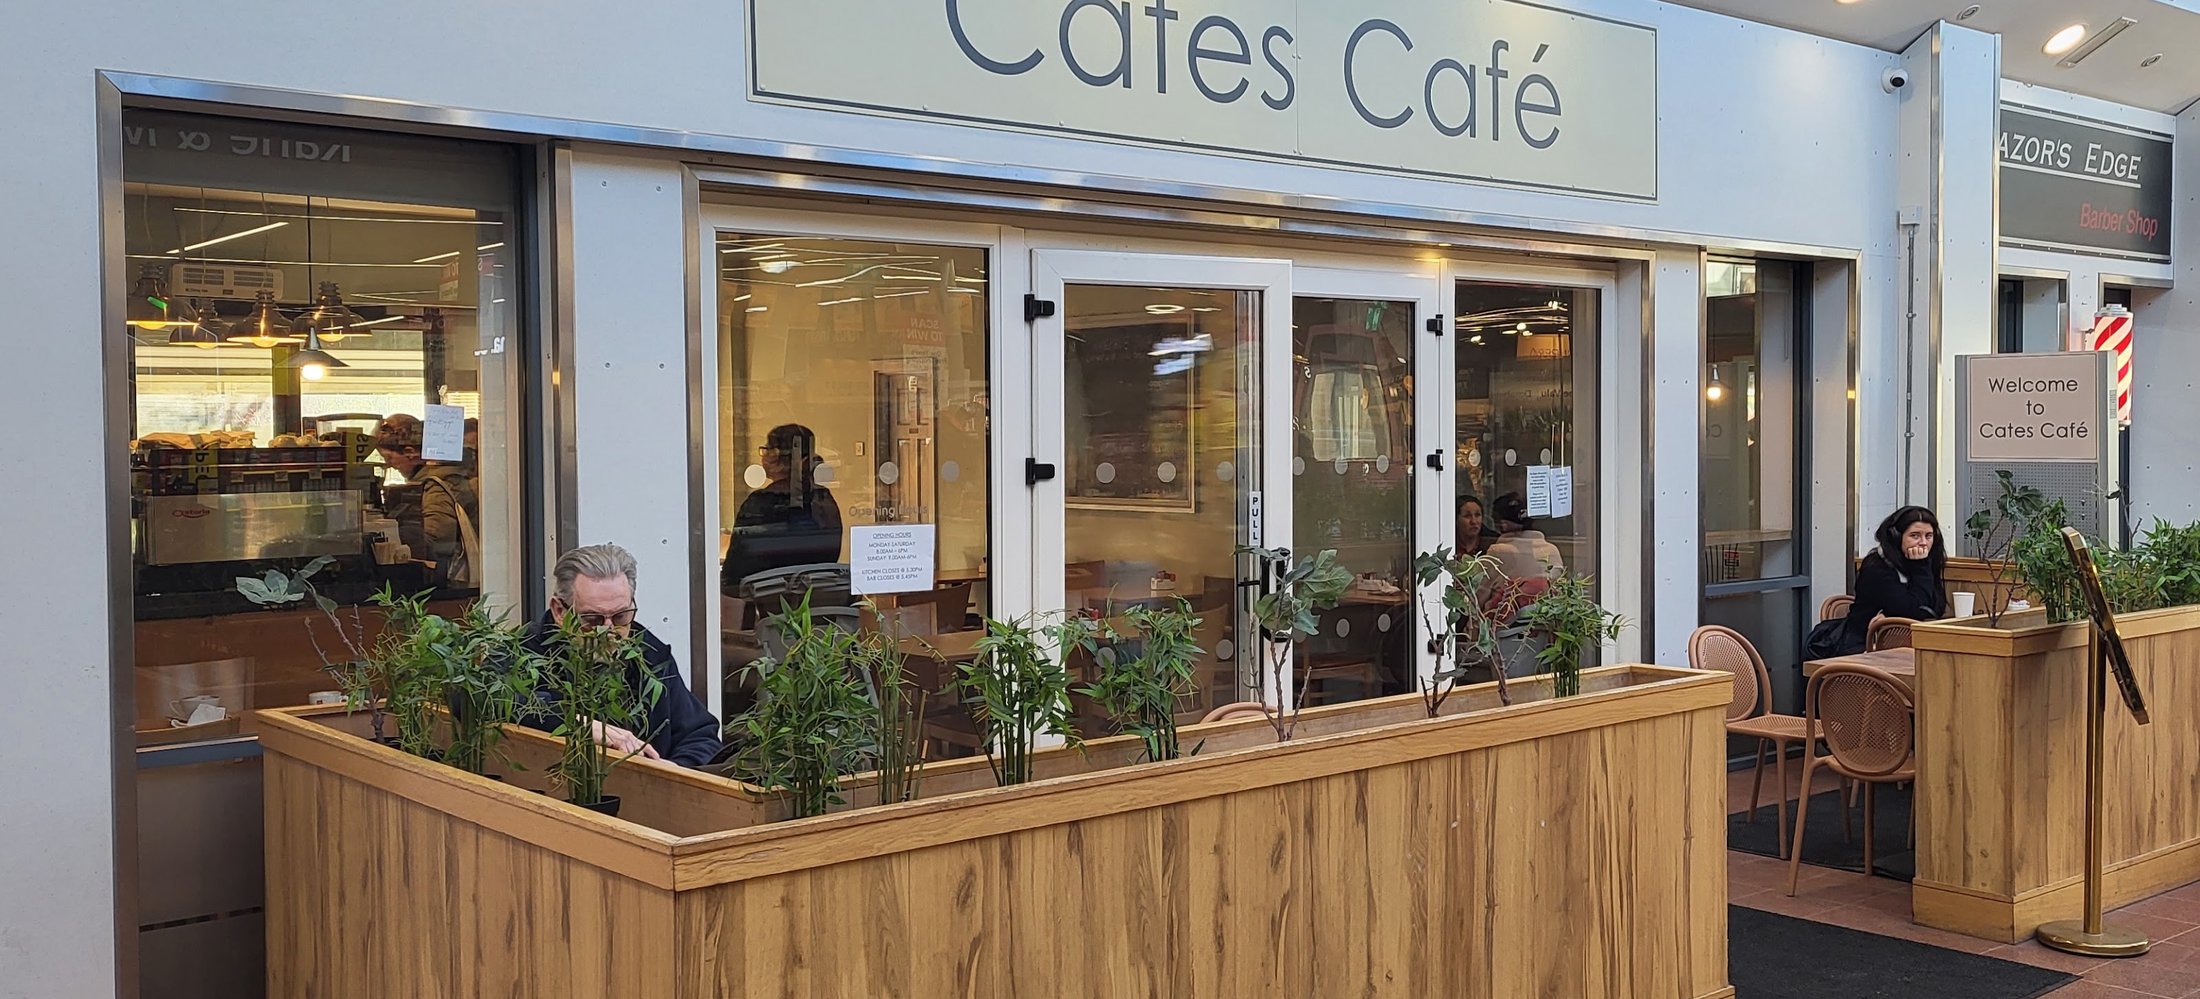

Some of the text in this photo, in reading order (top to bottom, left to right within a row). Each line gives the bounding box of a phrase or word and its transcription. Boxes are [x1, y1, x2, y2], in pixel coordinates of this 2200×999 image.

[945, 0, 1562, 150] Cates Café
[2084, 142, 2142, 180] EDGE
[2080, 201, 2158, 240] Barber Shop
[1988, 377, 2078, 393] Welcome
[2026, 400, 2045, 415] to
[1980, 421, 2088, 438] Cates Café
